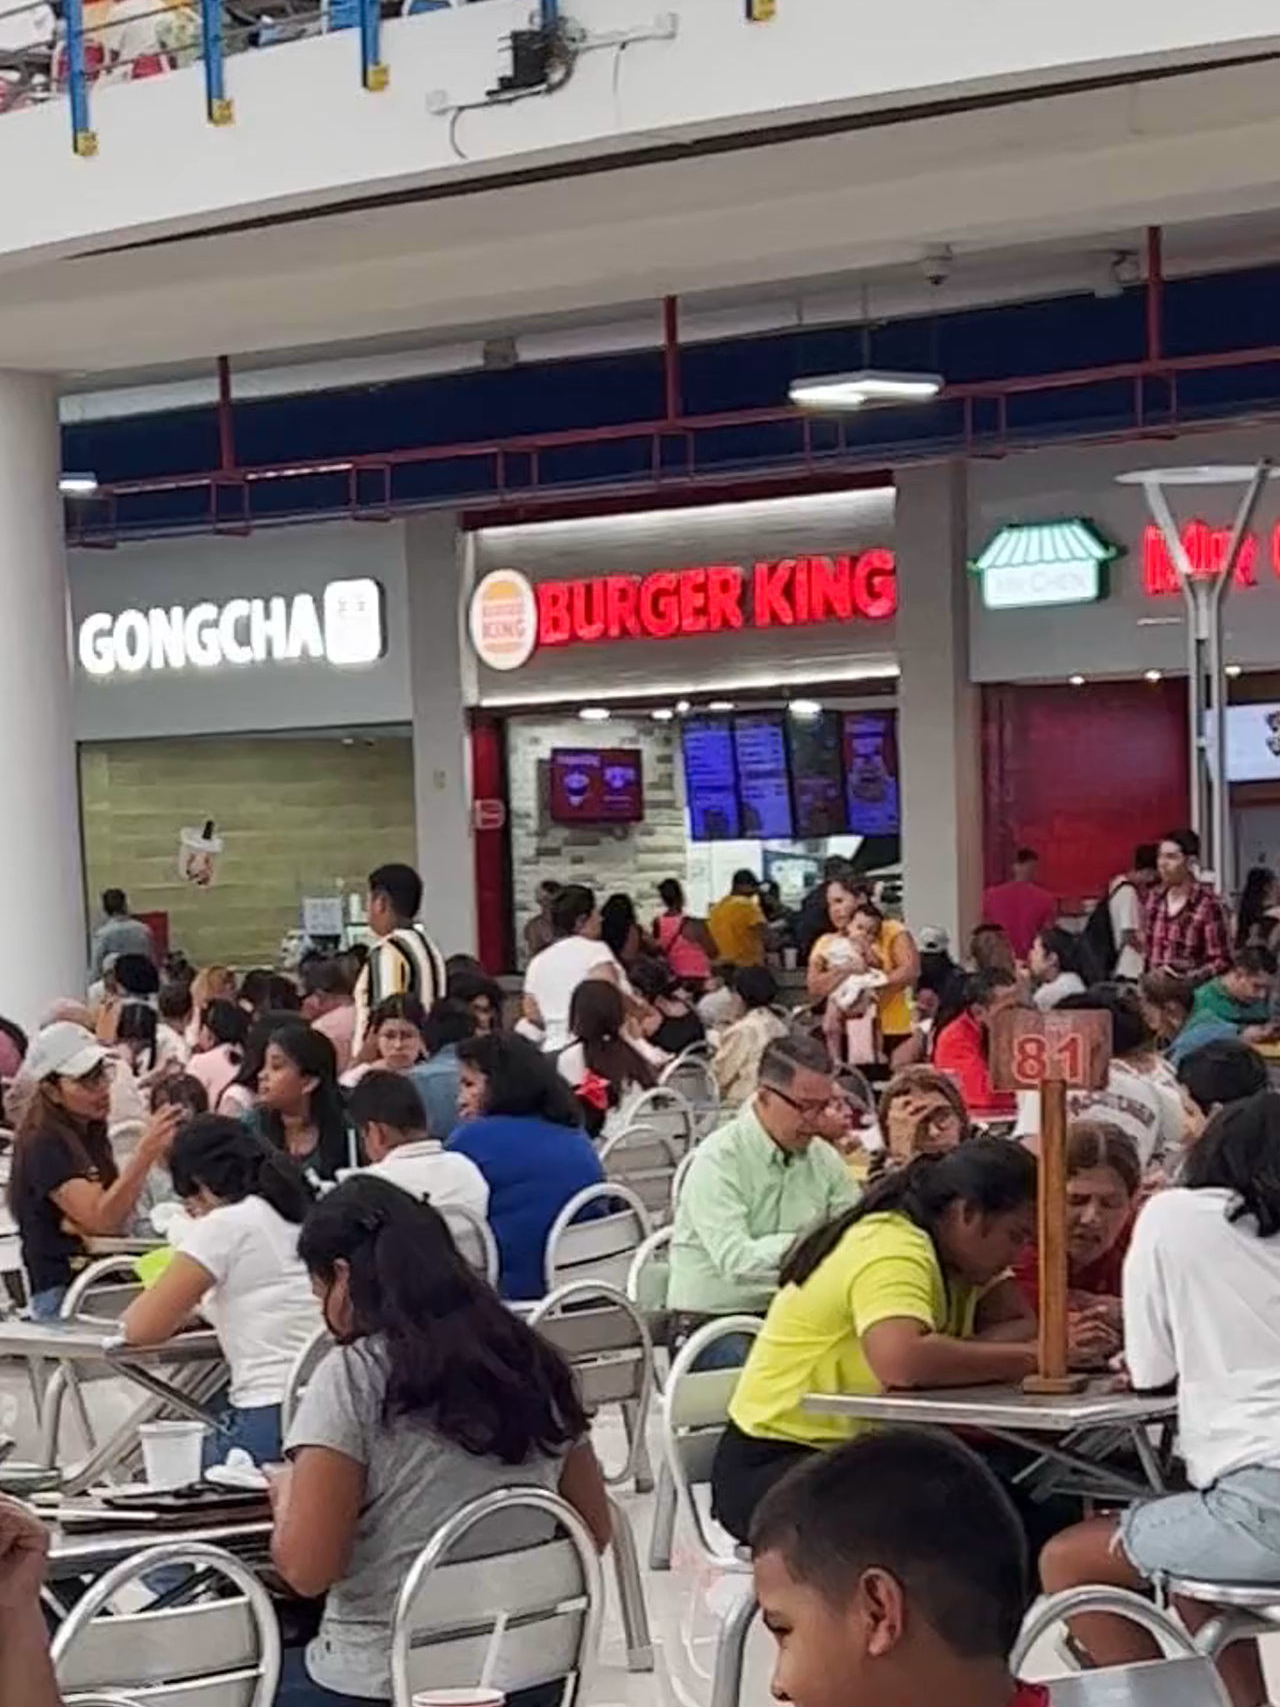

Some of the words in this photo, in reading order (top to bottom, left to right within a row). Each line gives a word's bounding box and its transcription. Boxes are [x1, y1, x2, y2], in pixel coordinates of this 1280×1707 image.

[78, 593, 324, 676] GONGCHA
[538, 565, 744, 646] BURGER
[752, 549, 898, 627] KING
[1012, 1034, 1083, 1084] 81
